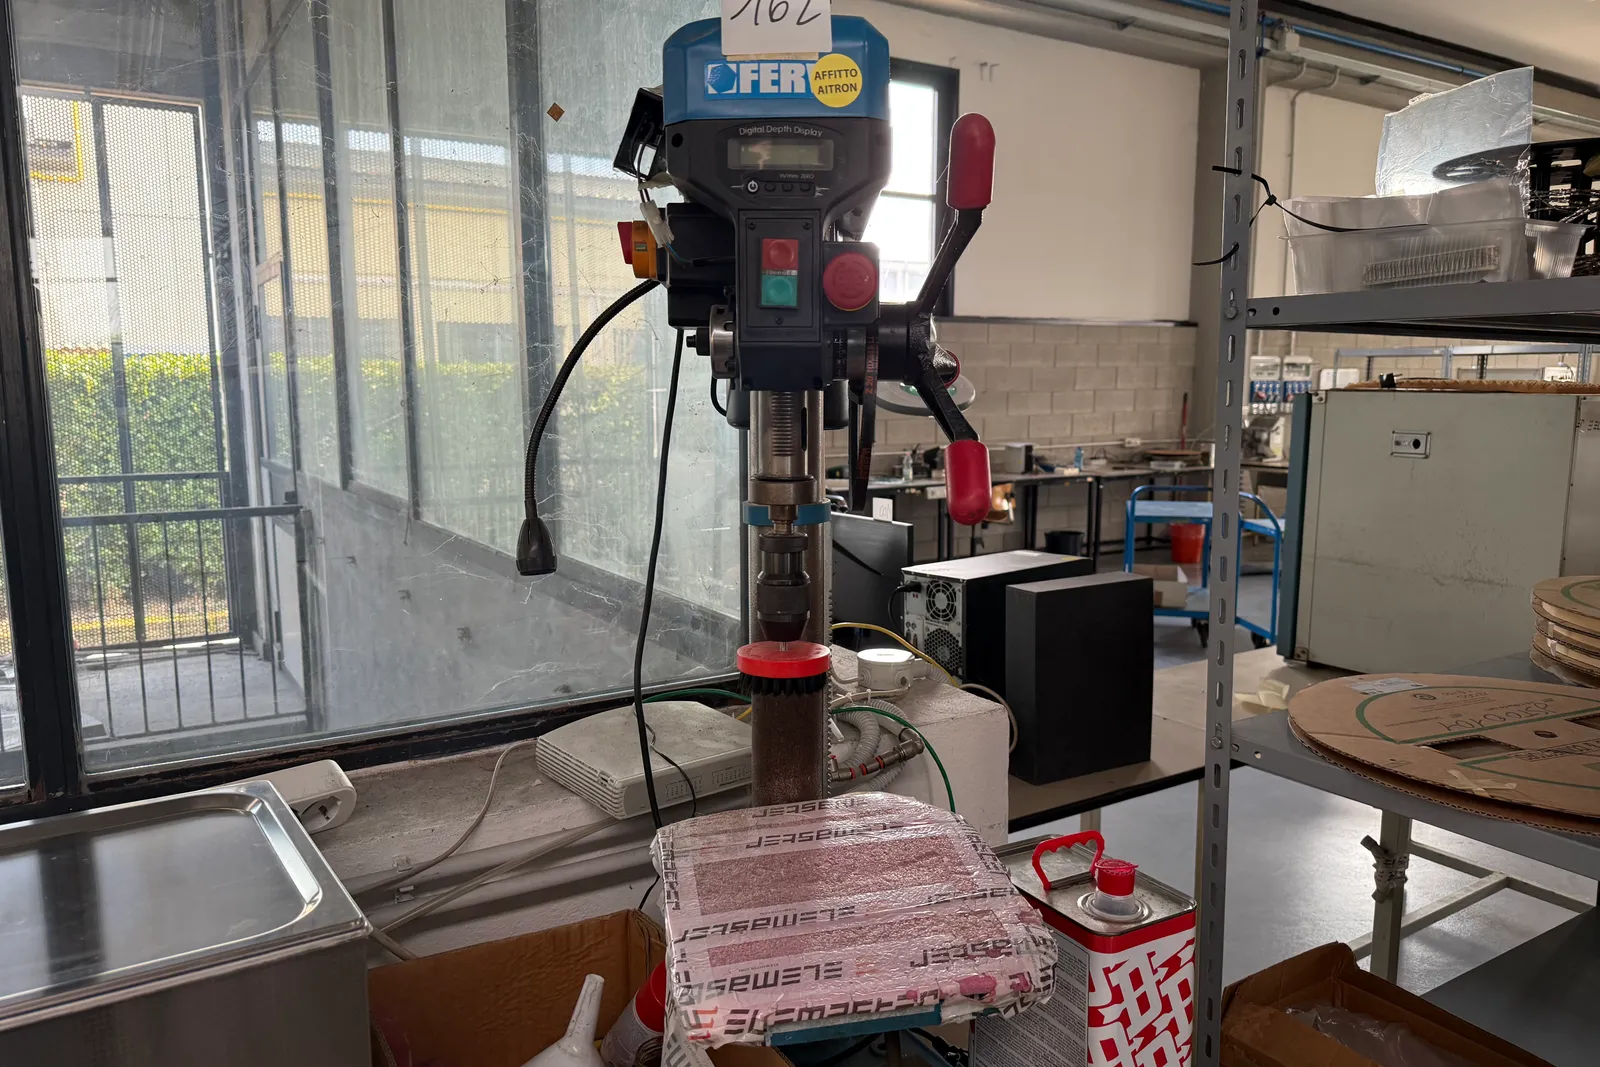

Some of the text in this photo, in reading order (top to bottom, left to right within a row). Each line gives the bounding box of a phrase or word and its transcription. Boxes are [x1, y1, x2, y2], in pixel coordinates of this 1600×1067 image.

[814, 68, 858, 81] AFFITTO
[817, 83, 857, 95] AITRON
[739, 125, 823, 138] Digital Depth Display
